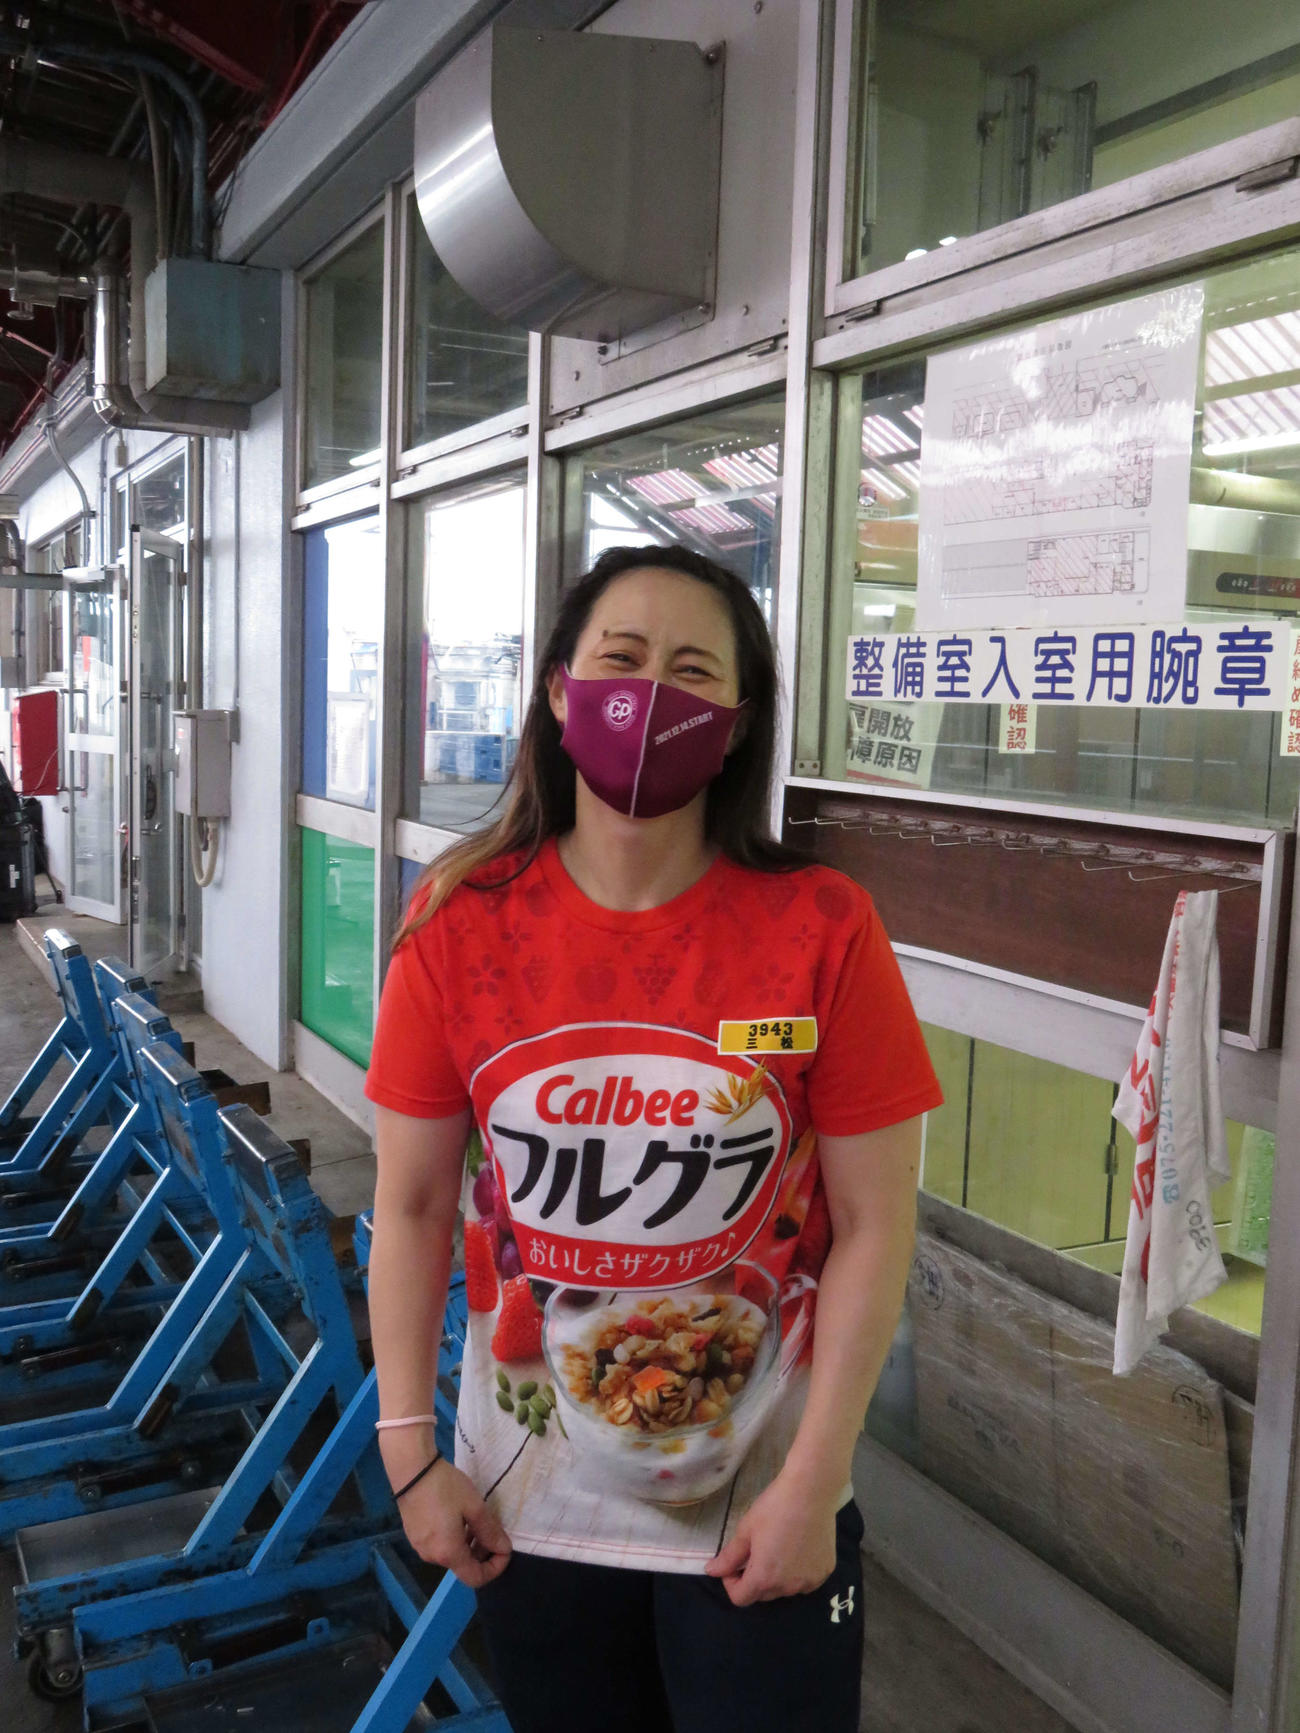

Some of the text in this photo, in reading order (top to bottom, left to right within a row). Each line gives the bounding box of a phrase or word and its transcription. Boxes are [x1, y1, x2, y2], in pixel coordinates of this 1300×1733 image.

[851, 625, 1275, 708] 整備室入室用腕章
[1007, 704, 1028, 751] 確認
[849, 736, 922, 774] 障原因
[748, 1022, 793, 1037] 3943
[535, 1074, 700, 1126] Calbee
[491, 1124, 775, 1229] フルグラ
